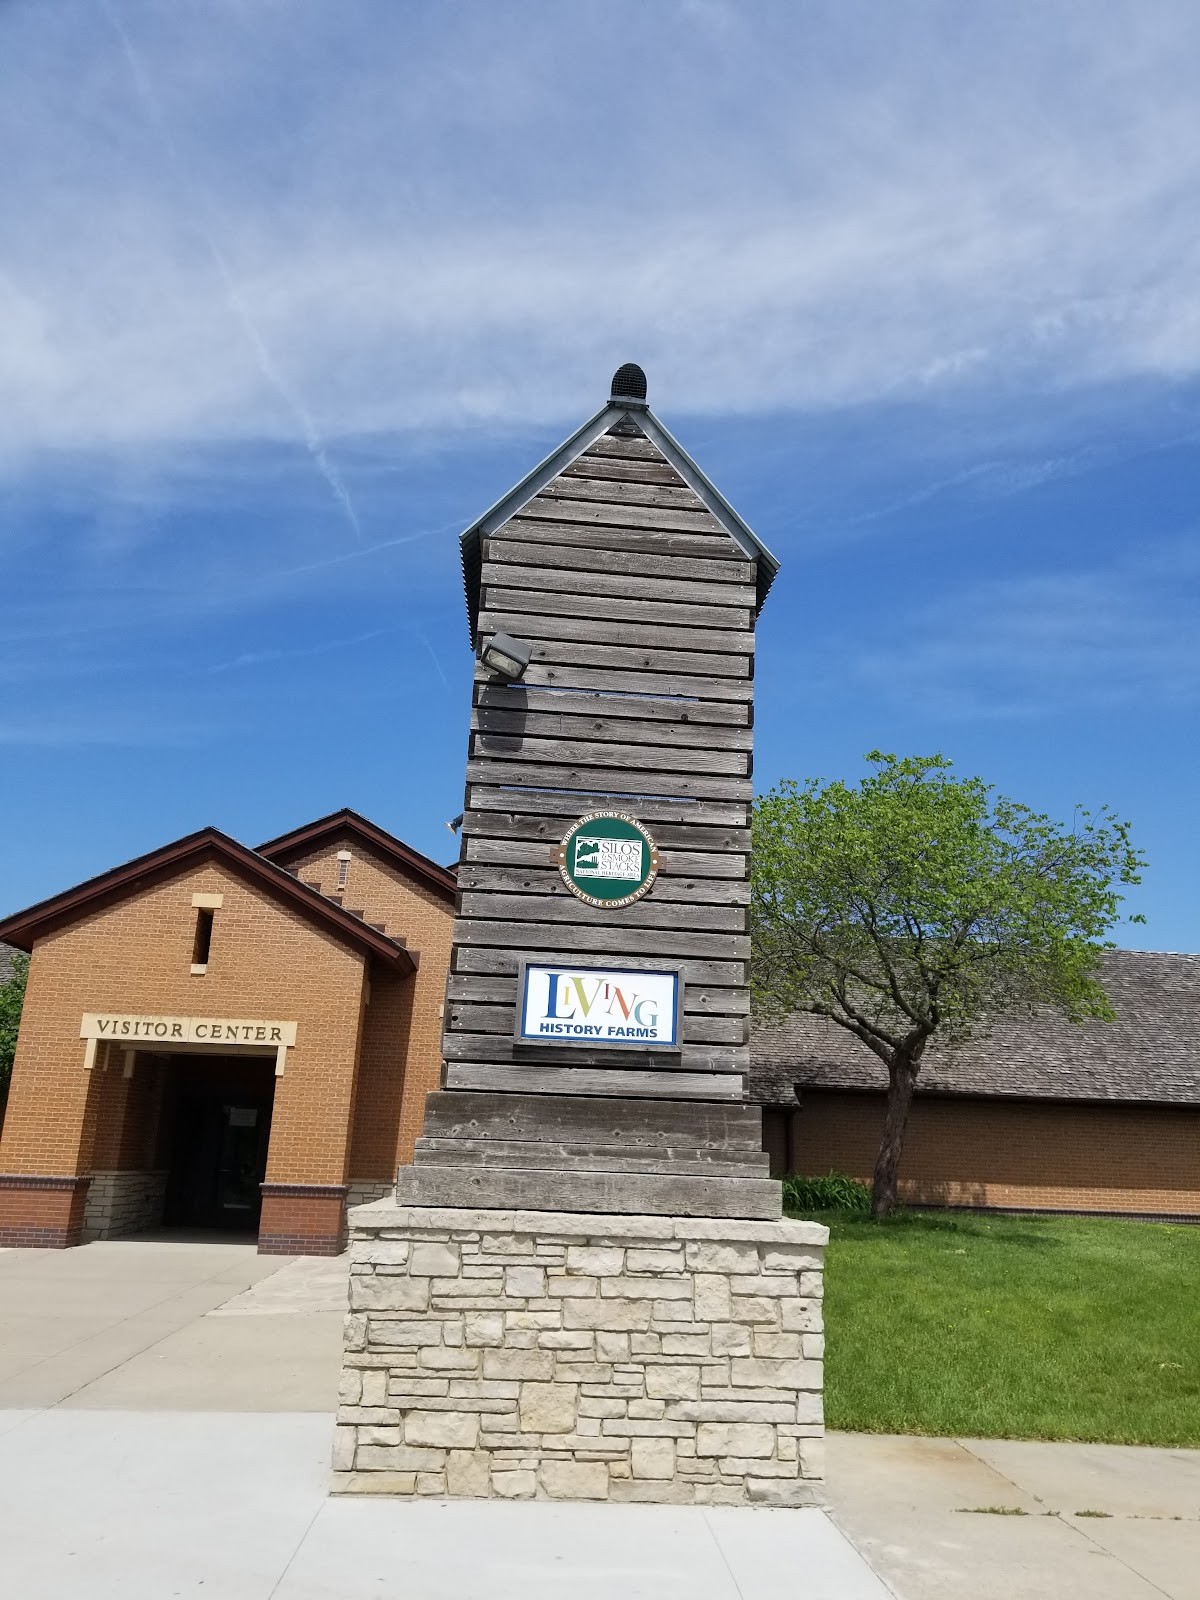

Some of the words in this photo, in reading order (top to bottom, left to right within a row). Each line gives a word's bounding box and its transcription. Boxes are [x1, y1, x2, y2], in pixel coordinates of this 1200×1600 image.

[561, 823, 580, 846] WHERE
[579, 813, 594, 825] THE
[620, 813, 632, 821] OF
[630, 819, 658, 853] AMERICAN
[602, 842, 640, 855] SILOS
[601, 861, 640, 872] STACKS
[559, 864, 604, 906] AGRICULTURE
[606, 896, 635, 907] COMES
[635, 888, 645, 898] TO
[643, 870, 657, 887] LIFE
[97, 1019, 183, 1037] VISITOR
[195, 1024, 282, 1041] CENTER
[539, 1023, 602, 1035] HISTORY
[607, 1026, 658, 1038] FARMS
